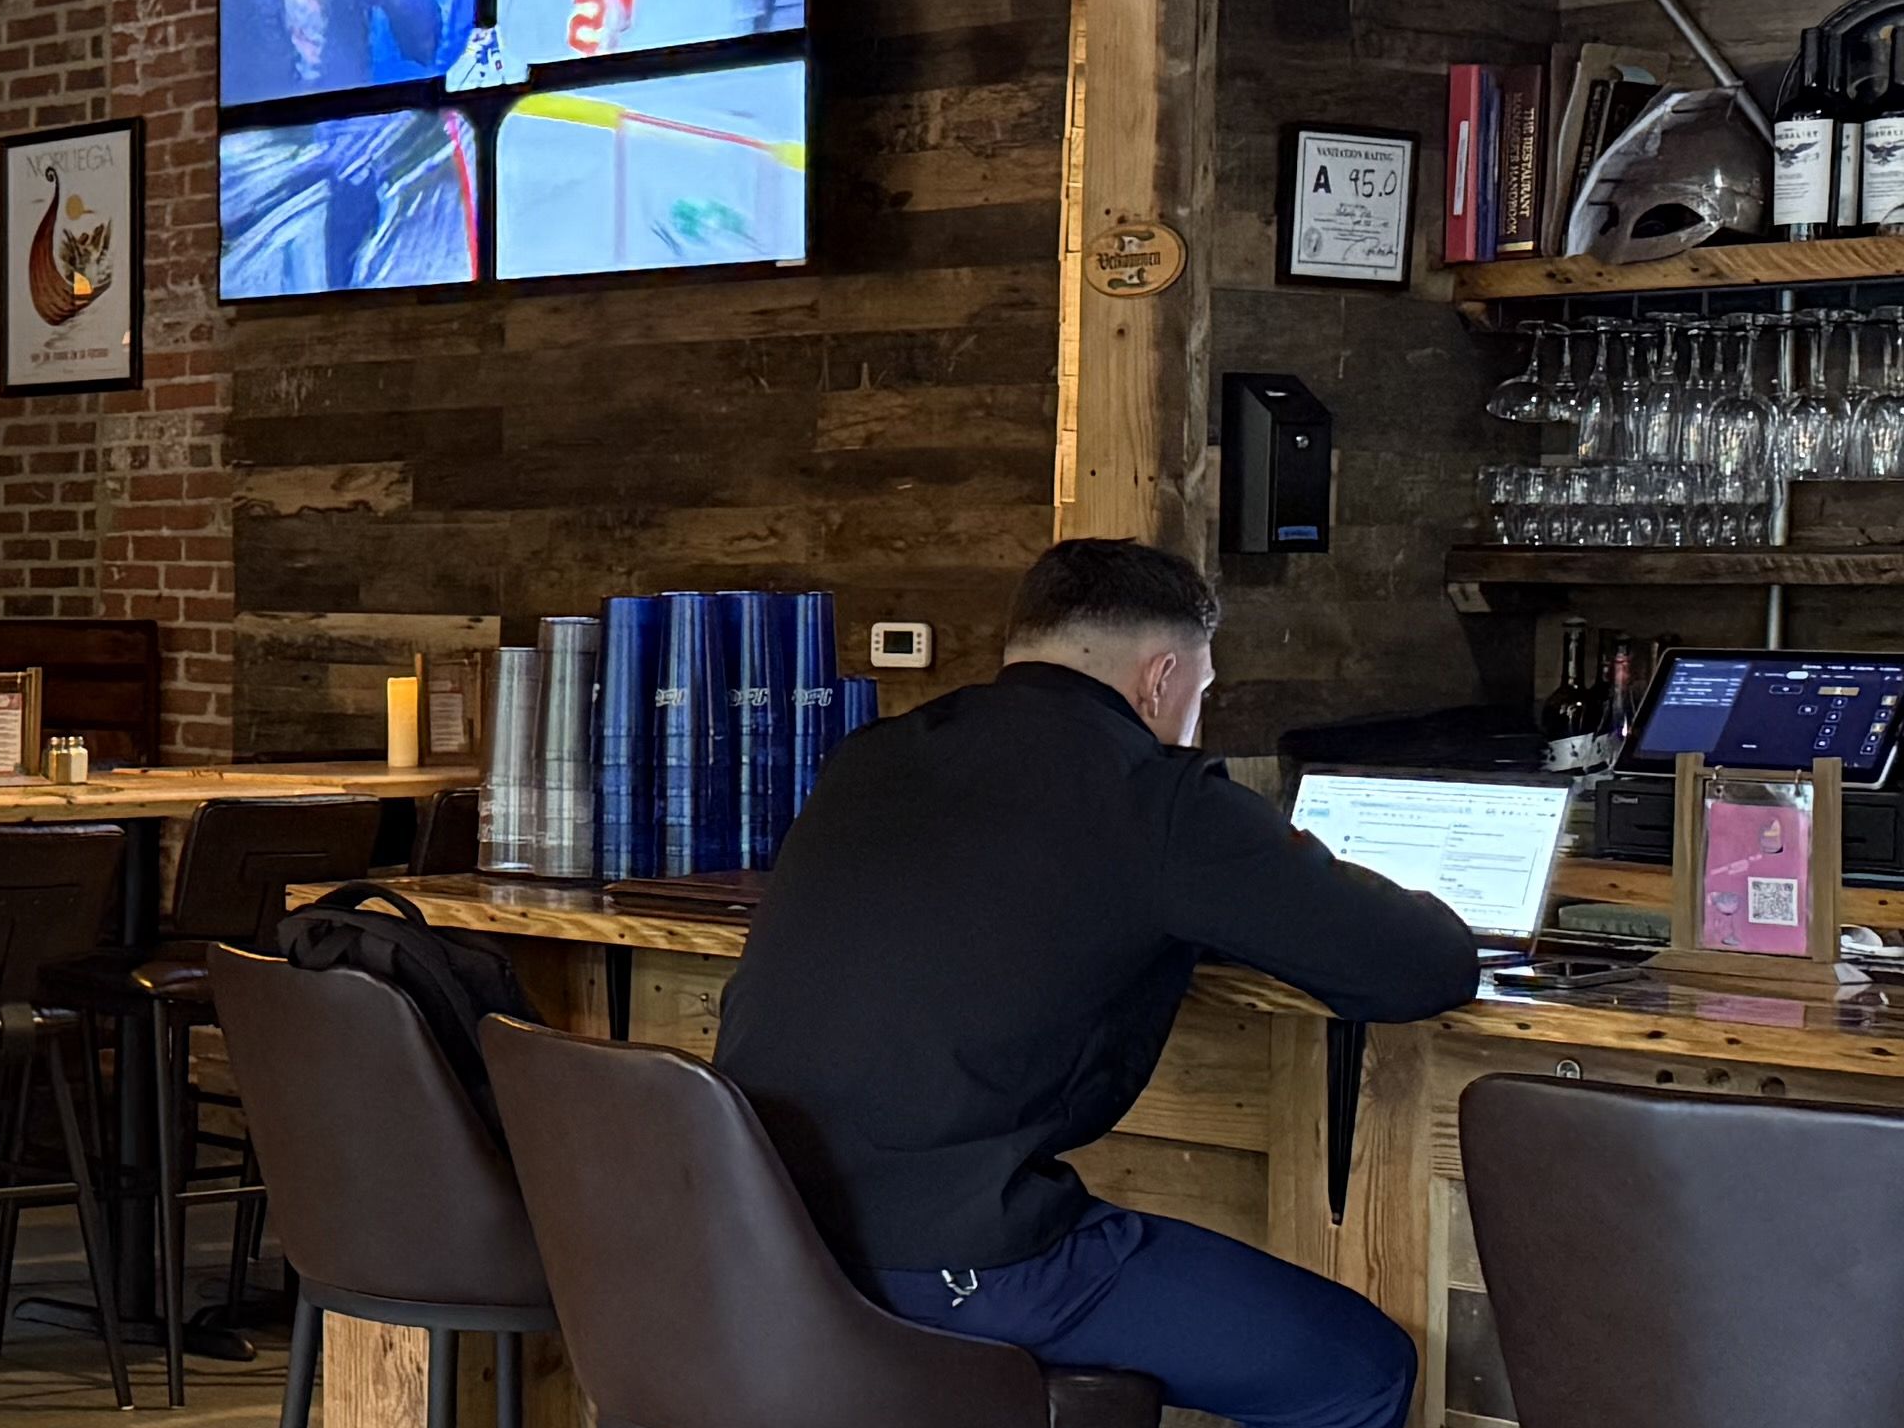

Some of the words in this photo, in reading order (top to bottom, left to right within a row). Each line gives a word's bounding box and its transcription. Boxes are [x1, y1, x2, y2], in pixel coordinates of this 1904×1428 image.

[1312, 164, 1332, 194] A
[1349, 168, 1398, 199] 95.0
[1520, 136, 1535, 218] RESTAURANT
